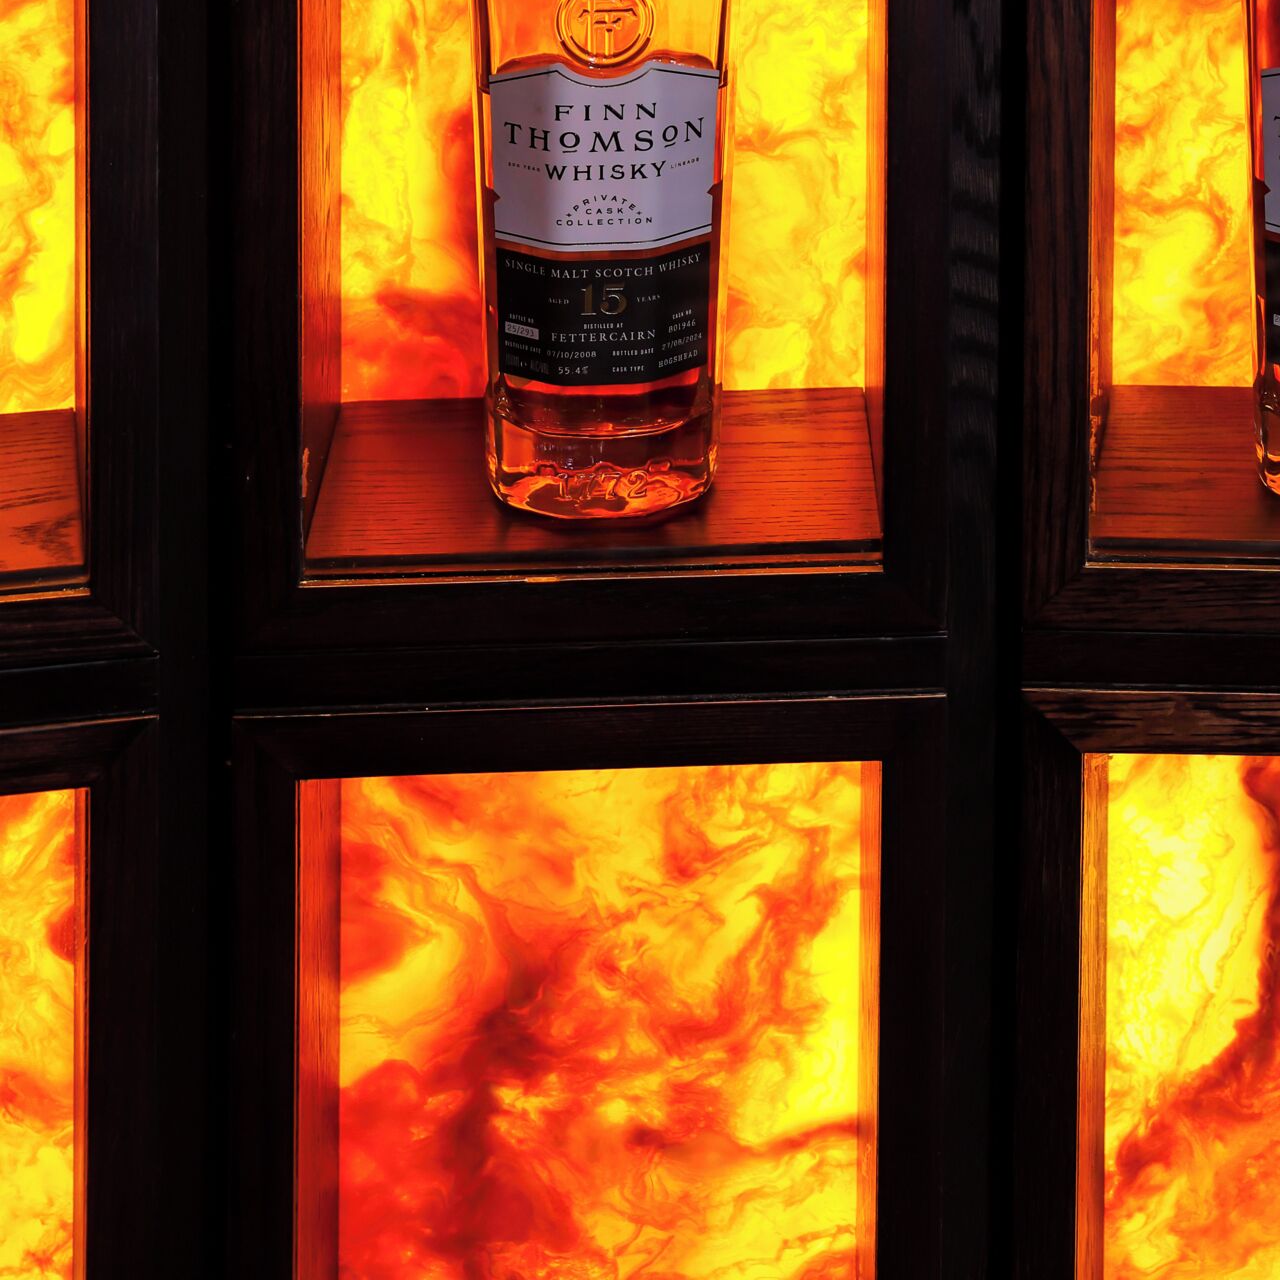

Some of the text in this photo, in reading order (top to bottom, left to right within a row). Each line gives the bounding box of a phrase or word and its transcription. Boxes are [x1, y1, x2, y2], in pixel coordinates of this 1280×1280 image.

[554, 102, 657, 121] FINN
[504, 117, 704, 153] THOMSON
[544, 160, 667, 181] WHISKY
[573, 194, 636, 212] PRIVATE
[556, 216, 653, 226] COLLECTION
[504, 252, 702, 279] SINGLE MALT SCOTCH WHISKY
[580, 282, 628, 316] 15
[551, 330, 656, 343] FETTERCAIRN
